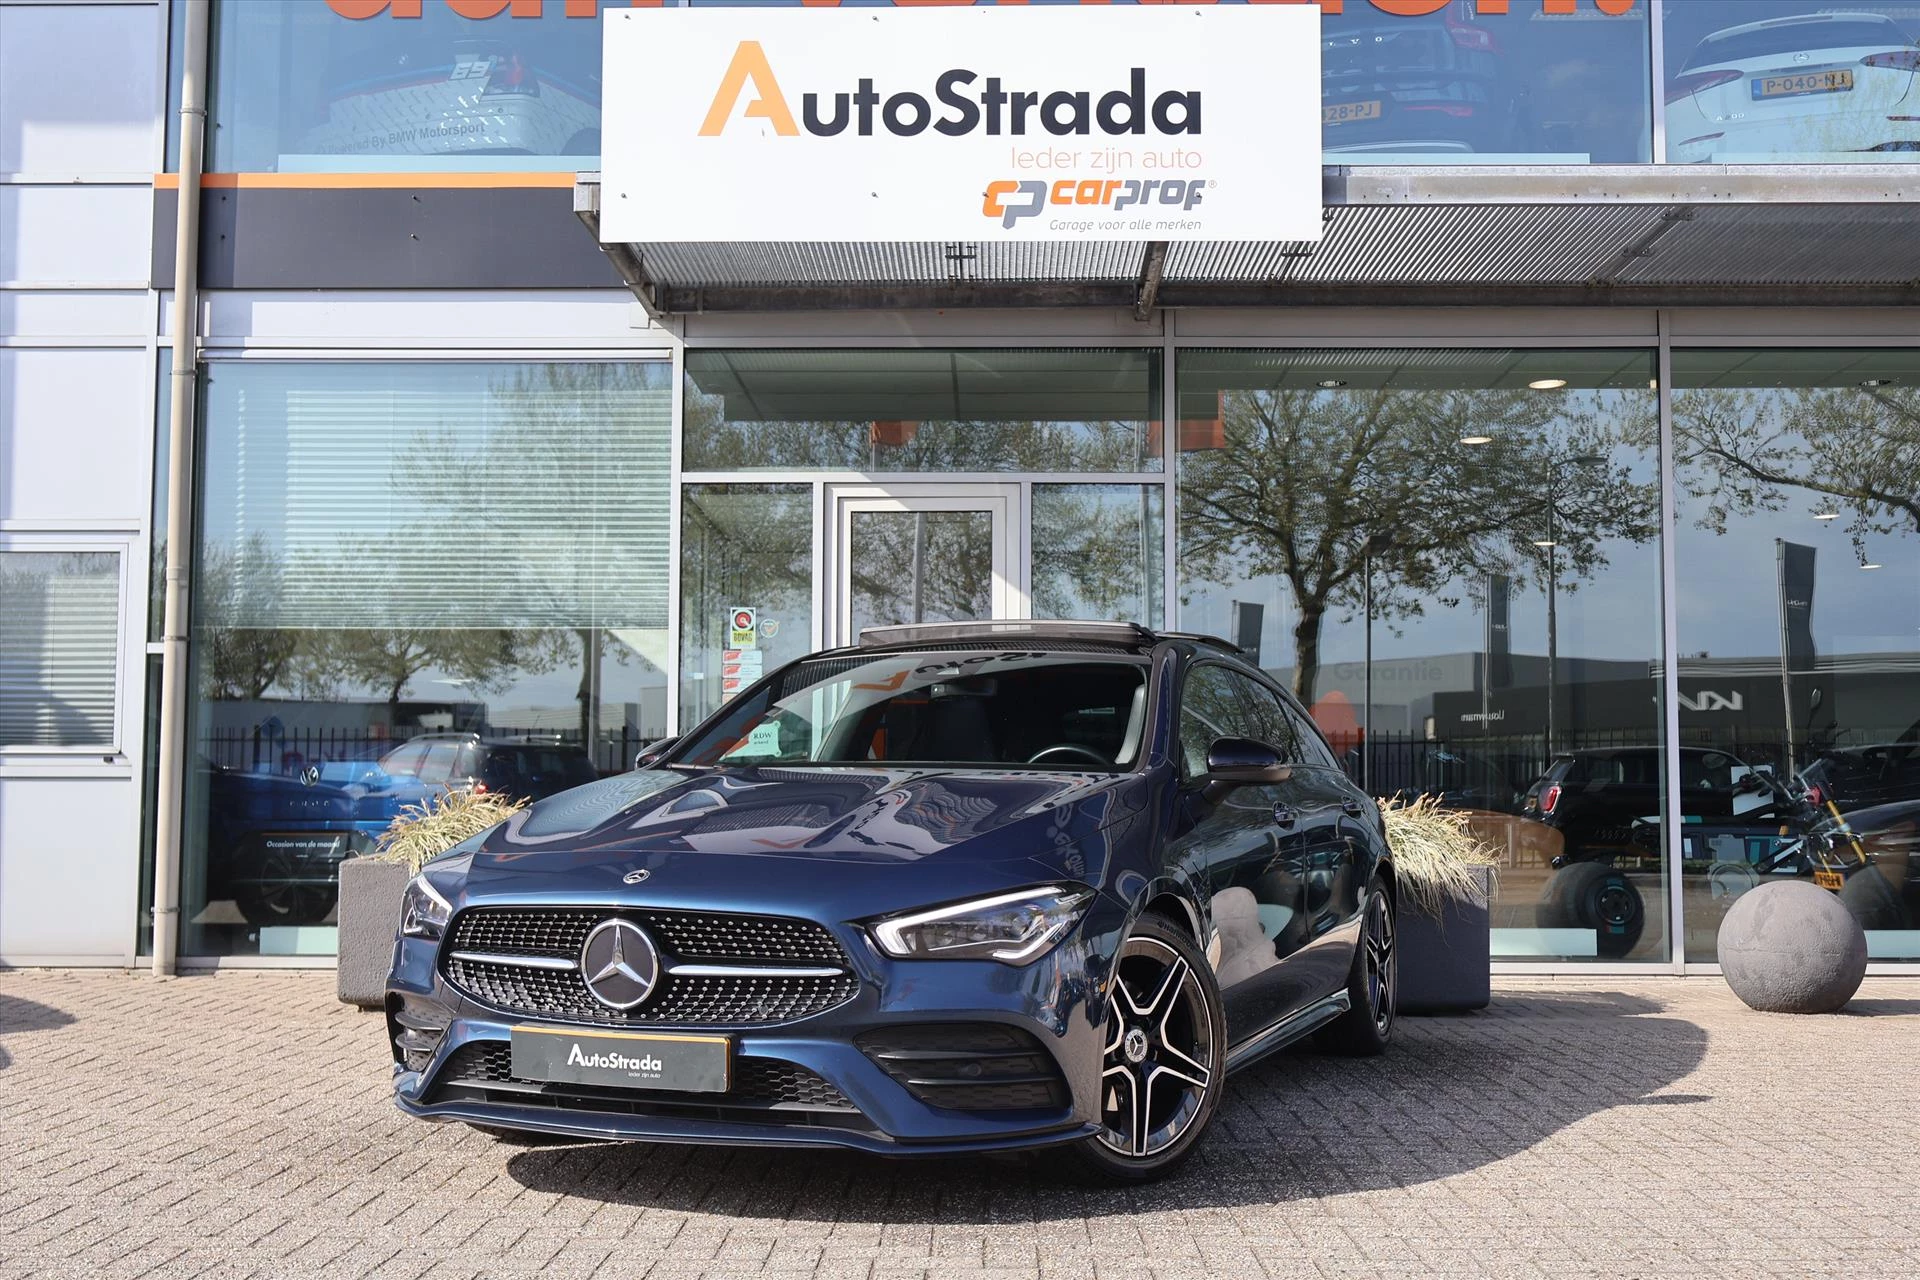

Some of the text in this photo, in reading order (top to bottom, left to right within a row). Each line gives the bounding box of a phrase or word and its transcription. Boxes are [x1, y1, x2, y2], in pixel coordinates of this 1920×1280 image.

[697, 41, 1202, 137] AutoStrada
[372, 135, 386, 149] By
[388, 129, 417, 144] BMW
[419, 123, 486, 139] Motorsport
[1011, 147, 1202, 174] Ieder zijn auto
[1050, 179, 1206, 211] carprof
[1050, 219, 1202, 233] Garage voor alle merken
[266, 840, 294, 848] Occasion
[307, 840, 316, 848] de
[567, 1043, 662, 1071] AutoStrada
